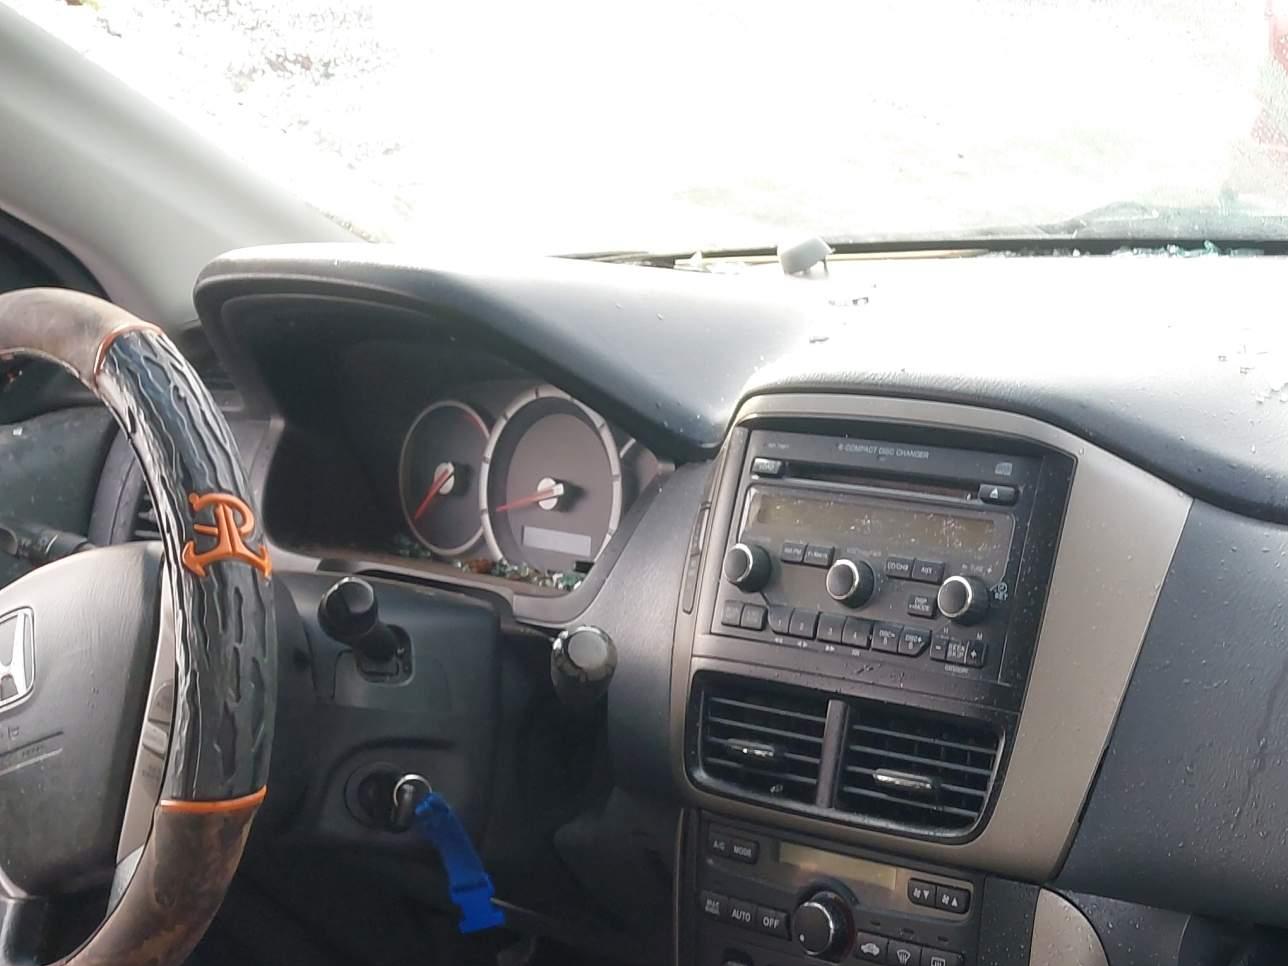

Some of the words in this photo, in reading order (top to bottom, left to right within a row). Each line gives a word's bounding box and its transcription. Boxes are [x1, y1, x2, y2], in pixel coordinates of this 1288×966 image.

[845, 444, 877, 456] COMPACT
[879, 447, 895, 456] DISC
[896, 448, 929, 460] CHANGER
[731, 907, 751, 923] AUTO
[762, 915, 780, 929] OFF
